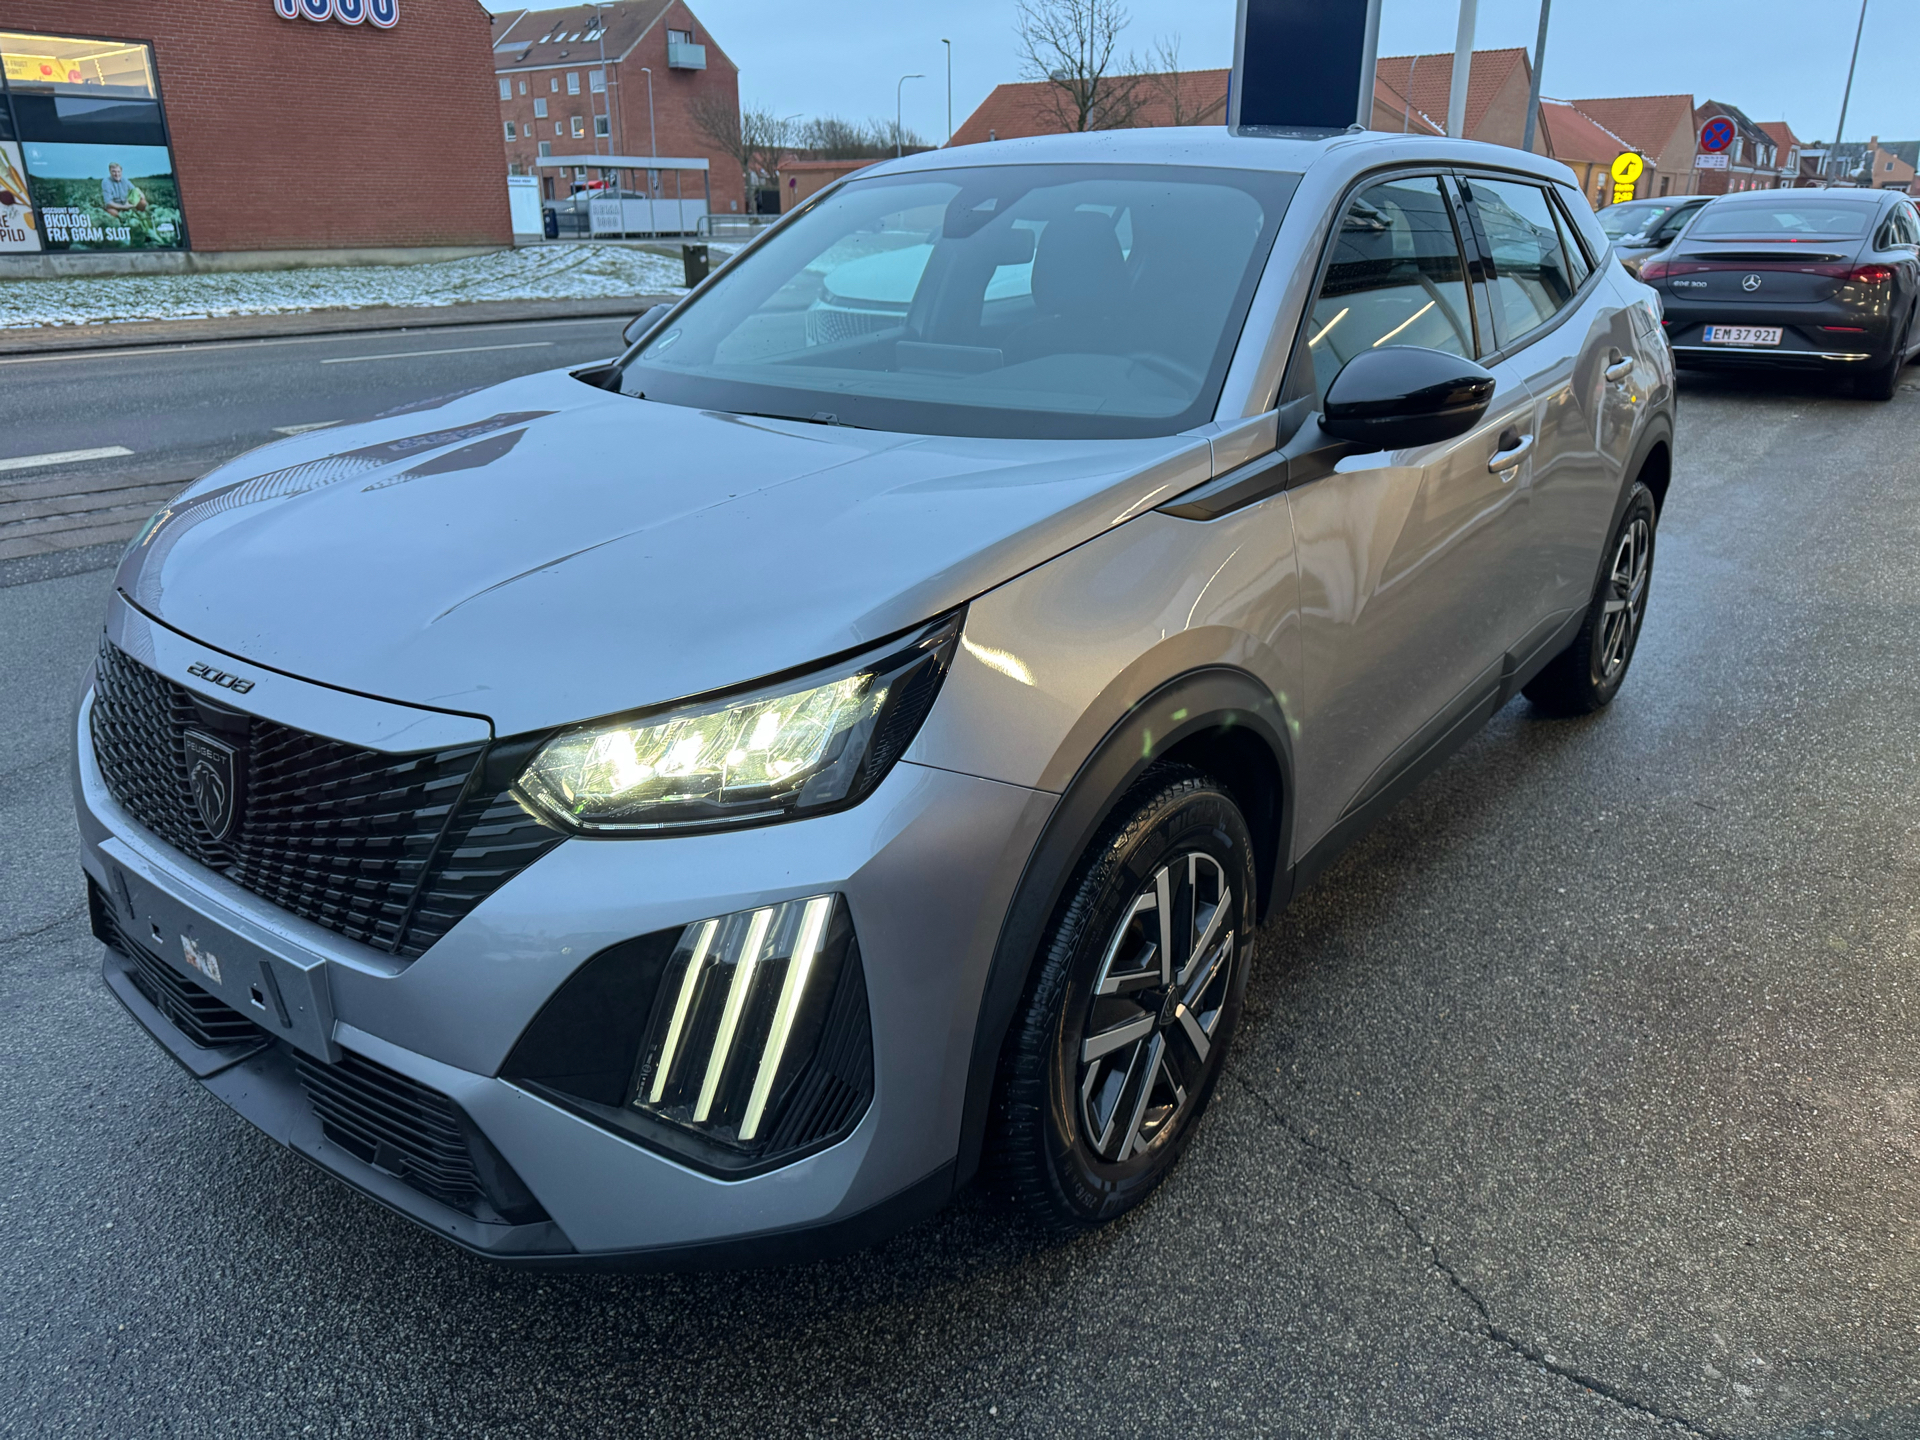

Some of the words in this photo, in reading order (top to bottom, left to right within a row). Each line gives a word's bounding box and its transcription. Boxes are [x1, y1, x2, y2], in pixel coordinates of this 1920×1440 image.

[43, 213, 91, 228] ØKOLOGI
[47, 227, 70, 242] FRA
[71, 227, 104, 242] GRAM
[105, 226, 131, 242] SLOT
[1713, 328, 1732, 340] EM
[1733, 329, 1751, 341] 37
[1754, 330, 1777, 342] 921
[186, 660, 256, 695] 2008
[186, 740, 228, 765] PEUGEOT
